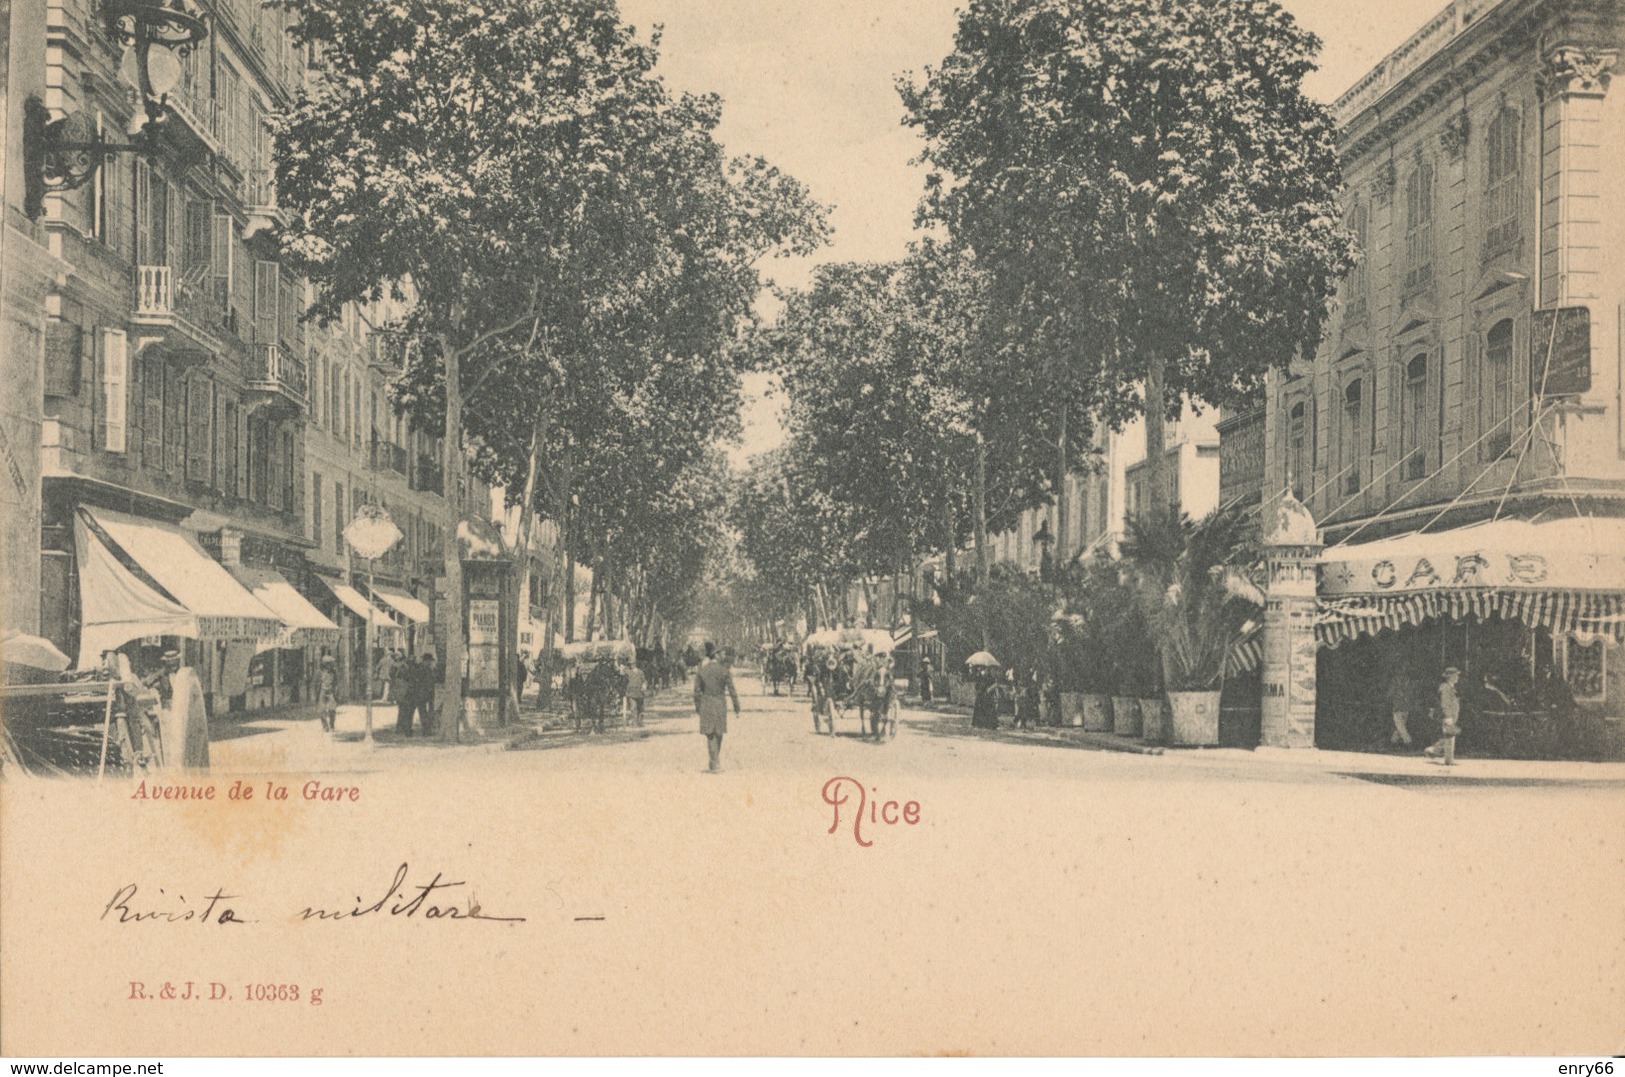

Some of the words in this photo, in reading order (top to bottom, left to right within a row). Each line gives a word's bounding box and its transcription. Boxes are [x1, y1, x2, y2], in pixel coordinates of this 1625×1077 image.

[131, 780, 216, 801] Avenue
[227, 780, 254, 801] de
[265, 781, 289, 801] la
[302, 780, 360, 802] Gare
[821, 776, 921, 848] Nice
[101, 883, 246, 925] Rivista
[301, 862, 527, 922] militare
[245, 984, 301, 1001] 10363
[310, 987, 324, 1006] g
